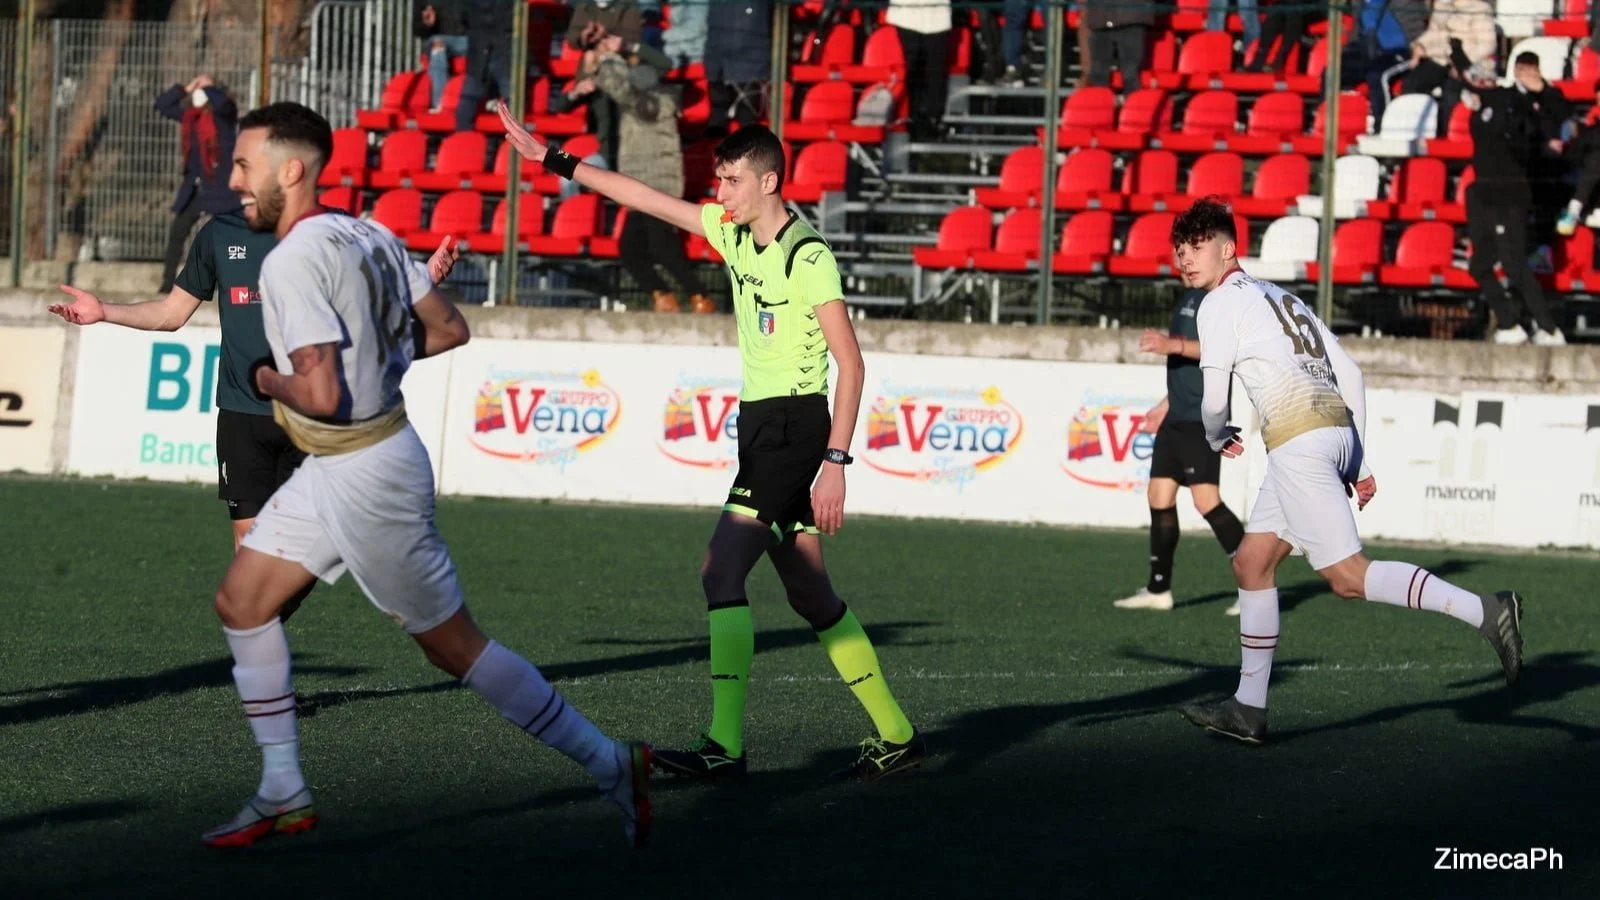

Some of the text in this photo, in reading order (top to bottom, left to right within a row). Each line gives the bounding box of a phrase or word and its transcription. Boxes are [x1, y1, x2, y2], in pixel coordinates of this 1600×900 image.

[1264, 292, 1324, 359] 16
[506, 388, 609, 434] Vena
[697, 395, 739, 441] Ve
[900, 404, 1009, 453] Vena
[945, 408, 1011, 425] GRUPPO
[140, 432, 217, 466] Banc
[1102, 413, 1155, 461] Ve
[1424, 483, 1496, 502] marconi
